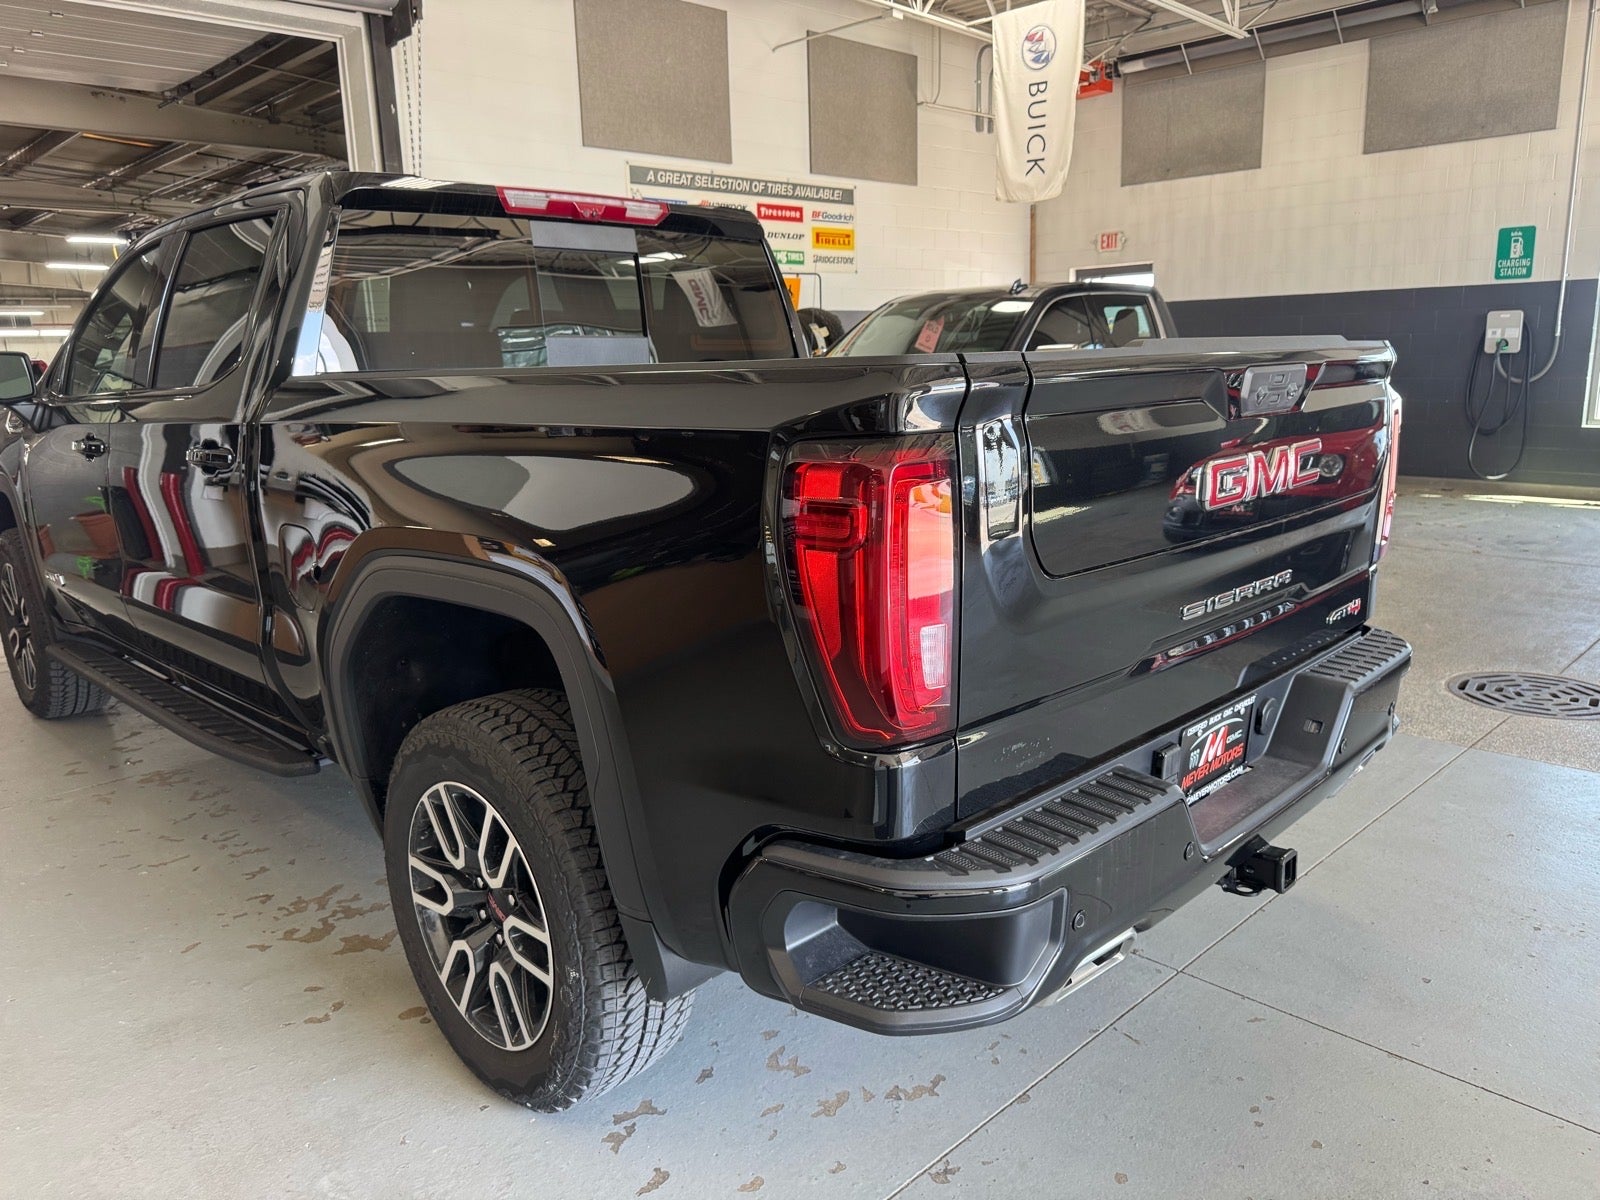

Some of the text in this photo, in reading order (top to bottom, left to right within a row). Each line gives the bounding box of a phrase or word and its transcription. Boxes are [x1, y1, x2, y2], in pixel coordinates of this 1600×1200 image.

[1025, 80, 1048, 176] BUICK
[646, 171, 843, 201] A GREAT SELECTION OF TIRES AVAILABLE!
[760, 207, 801, 219] Firestone
[811, 211, 854, 221] BFGoodrich
[767, 231, 805, 241] DUNLOP
[815, 232, 851, 246] PIRELLI
[1101, 233, 1118, 250] EXIT
[813, 254, 854, 265] BRIDGESTONE
[1497, 258, 1531, 268] CHARGING
[1499, 267, 1527, 277] STATION
[1204, 438, 1322, 511] GMC
[1182, 569, 1293, 621] SIERRA
[1226, 729, 1243, 744] GMC
[1181, 743, 1244, 790] MEYER MOTORS
